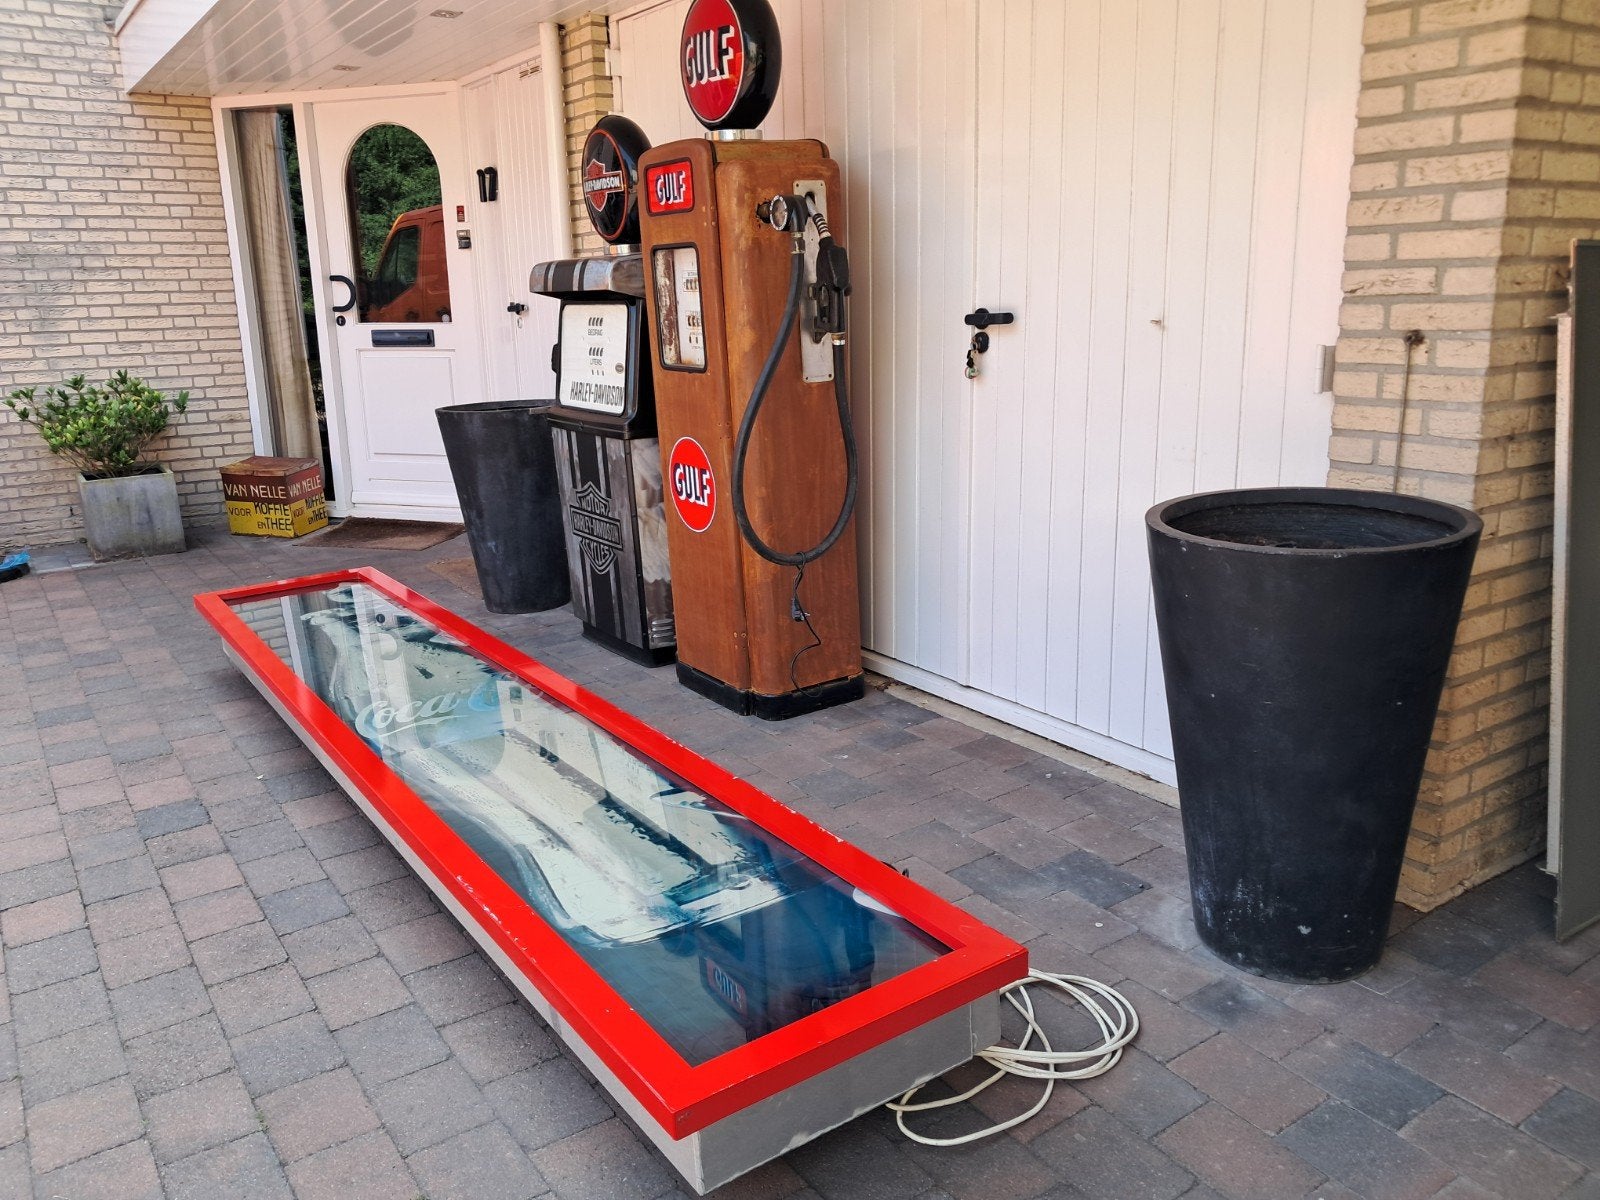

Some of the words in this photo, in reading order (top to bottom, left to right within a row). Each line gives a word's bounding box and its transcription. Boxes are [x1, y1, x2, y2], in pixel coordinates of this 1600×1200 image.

[686, 25, 735, 88] GULF
[655, 171, 686, 206] GULF
[570, 381, 625, 407] HARLEY-DAVIDSON
[224, 483, 248, 497] VAN
[249, 484, 287, 499] NELLE
[288, 482, 302, 498] VAN
[302, 475, 321, 494] NELLE
[674, 463, 710, 507] GULF
[229, 507, 252, 517] VOOR
[254, 502, 290, 516] KOFFIE
[580, 494, 607, 515] MOTOR
[264, 517, 292, 531] THEE
[573, 511, 620, 545] HARLEY-DAVIDSON
[585, 539, 610, 563] CYCLES
